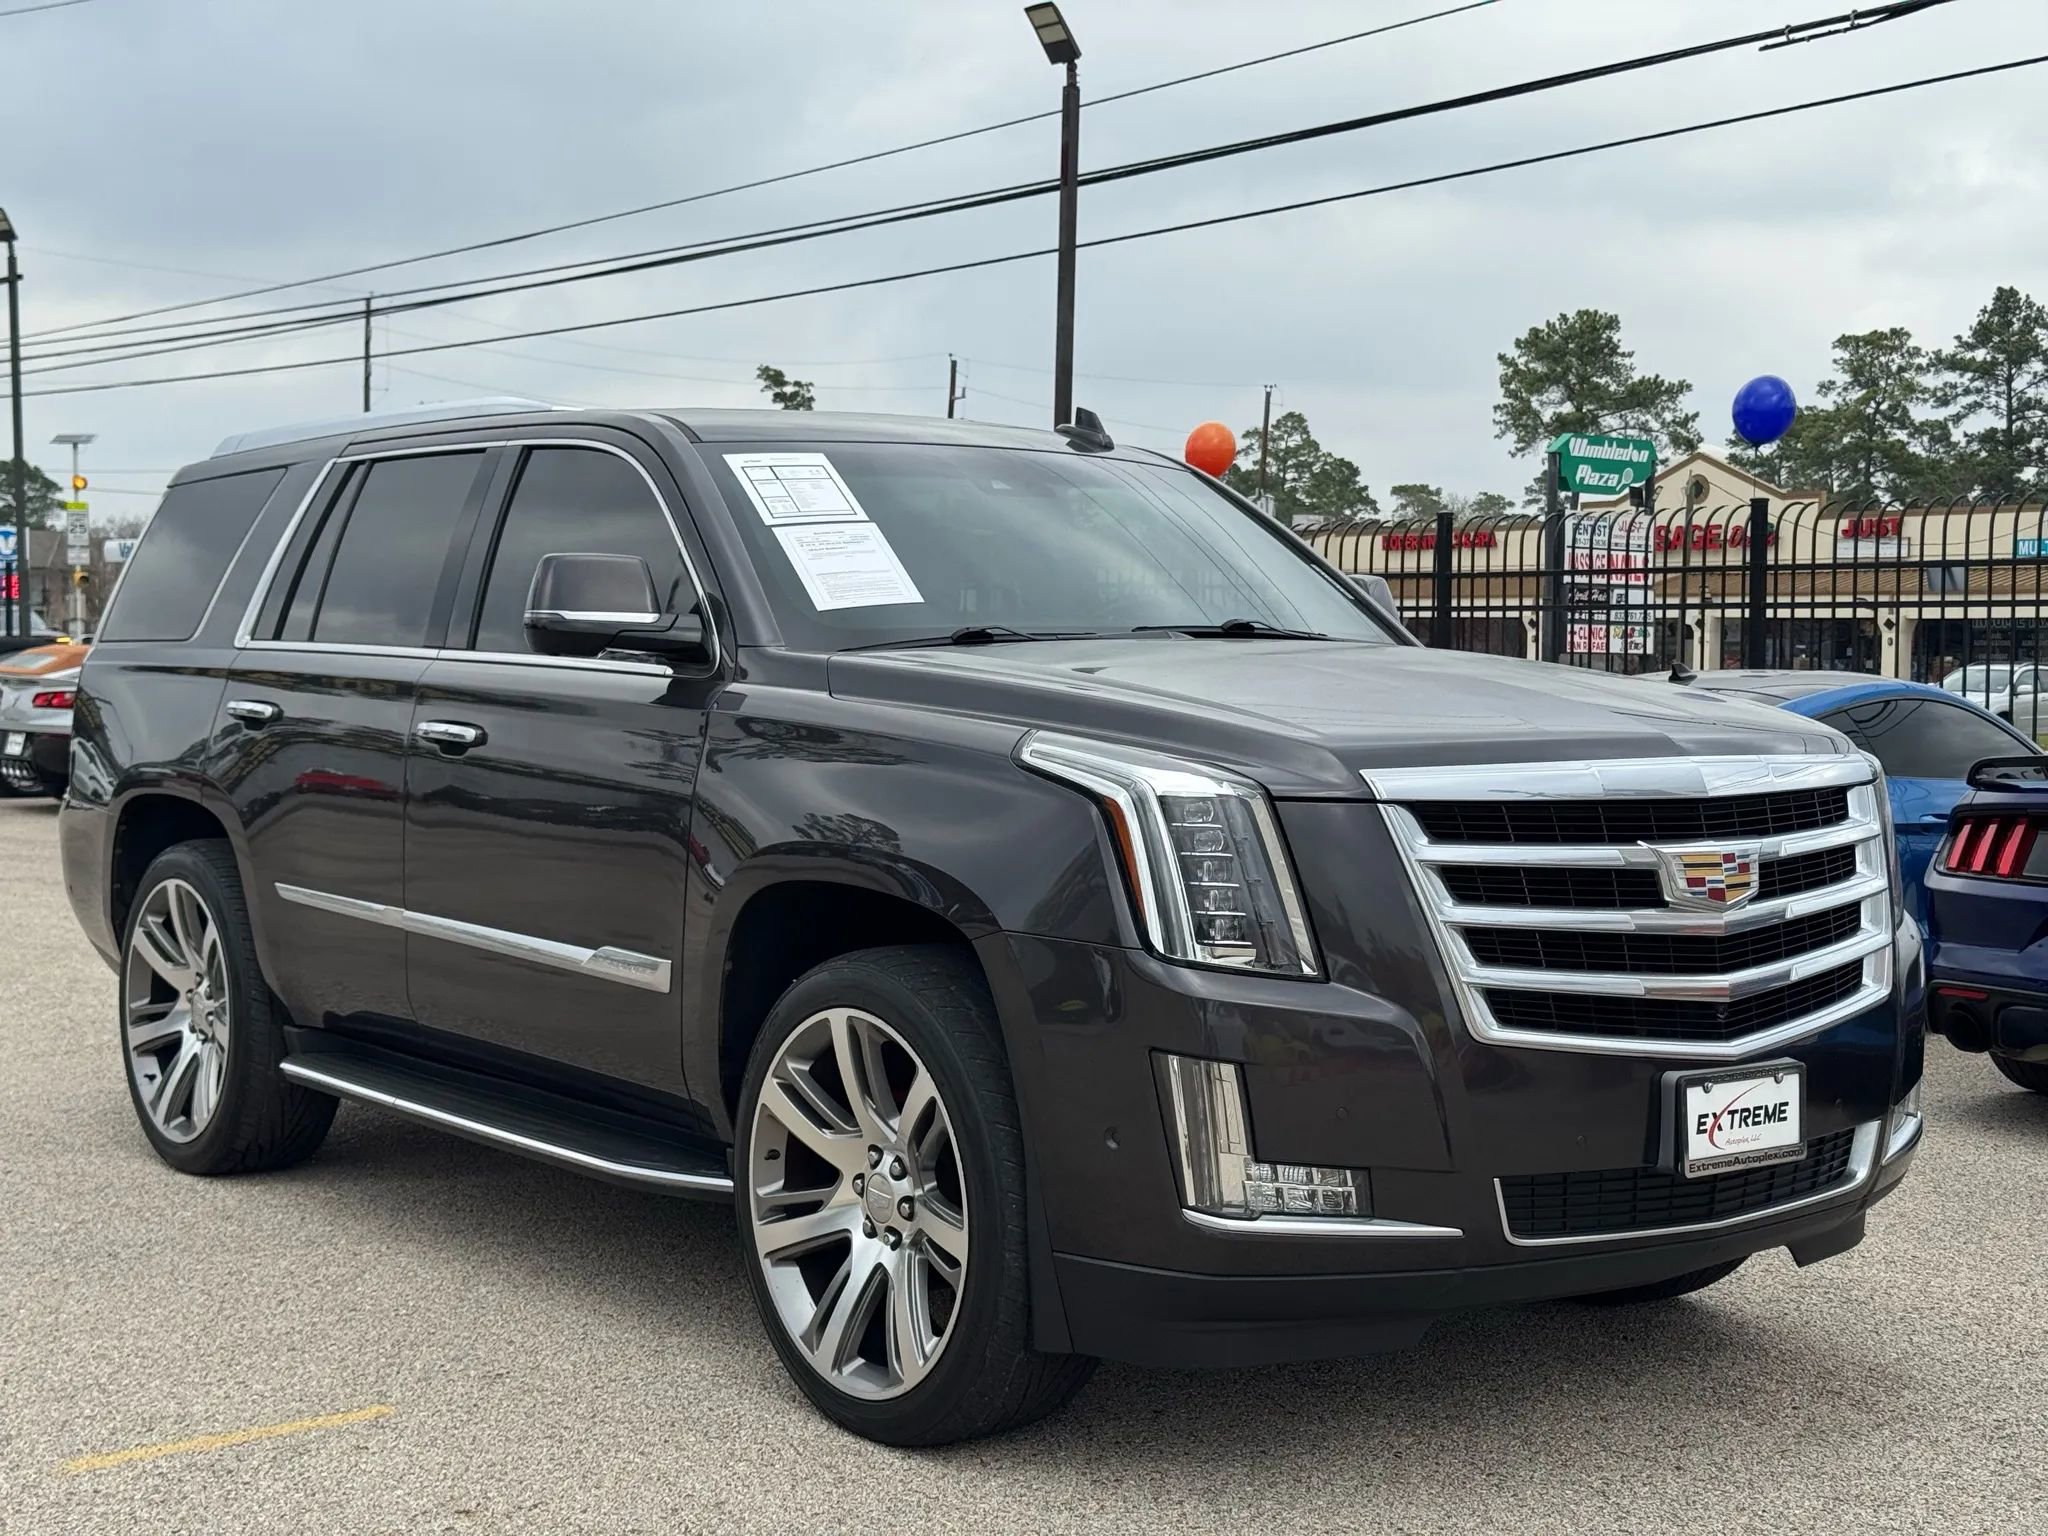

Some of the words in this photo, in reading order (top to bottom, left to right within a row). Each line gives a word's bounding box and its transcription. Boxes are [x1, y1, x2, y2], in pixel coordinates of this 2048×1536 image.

[1568, 437, 1649, 463] Wimbledon
[1575, 464, 1619, 487] Plaza
[70, 524, 87, 534] 25
[1572, 522, 1607, 538] ENTST
[1841, 517, 1899, 538] JUST
[2018, 540, 2048, 555] MUT
[1567, 551, 1606, 579] ASSGE
[1609, 553, 1649, 582] NAIL
[1578, 626, 1608, 640] CLNICA
[1583, 642, 1608, 652] RFAE
[1696, 1101, 1789, 1135] EXTREME
[1688, 1147, 1805, 1173] ExtremeAutoplex.com
